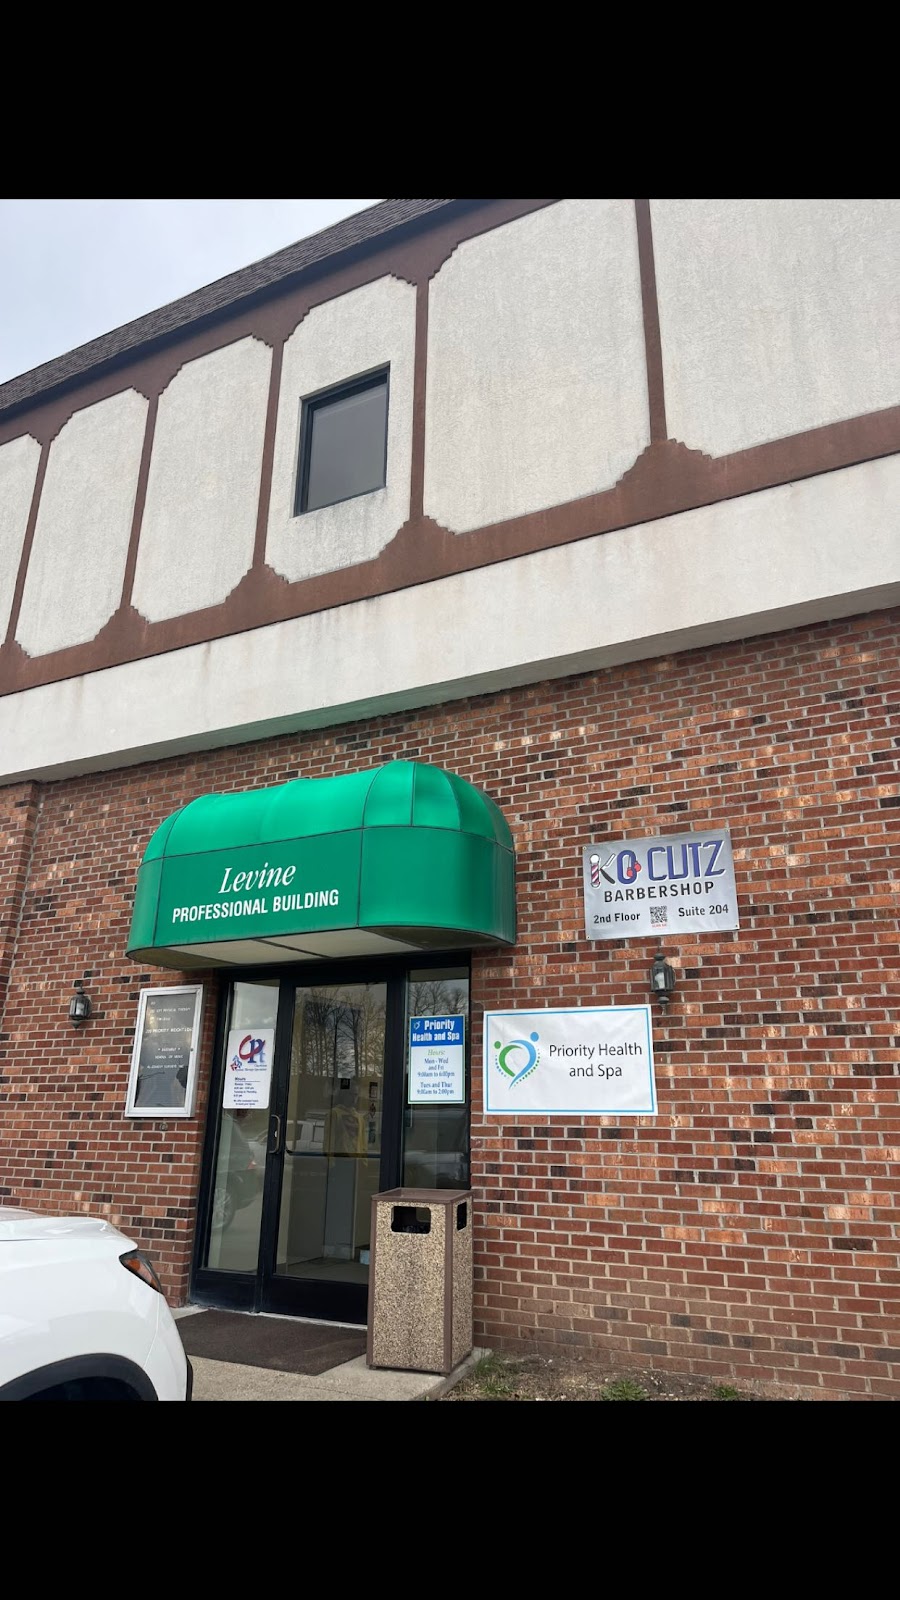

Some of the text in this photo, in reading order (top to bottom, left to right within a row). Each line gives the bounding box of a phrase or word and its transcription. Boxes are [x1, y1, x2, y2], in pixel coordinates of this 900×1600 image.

[647, 840, 727, 881] CUTZ
[217, 862, 297, 894] Levine
[604, 881, 715, 903] BARBERSHOP
[172, 889, 339, 924] PROFESSIONAL BUILDING
[593, 904, 729, 924] 2nd Floor Suite 204
[424, 1019, 455, 1031] Priority
[412, 1031, 460, 1042] Health and Spa
[549, 1042, 643, 1059] Priority Health
[569, 1064, 622, 1080] and Spa
